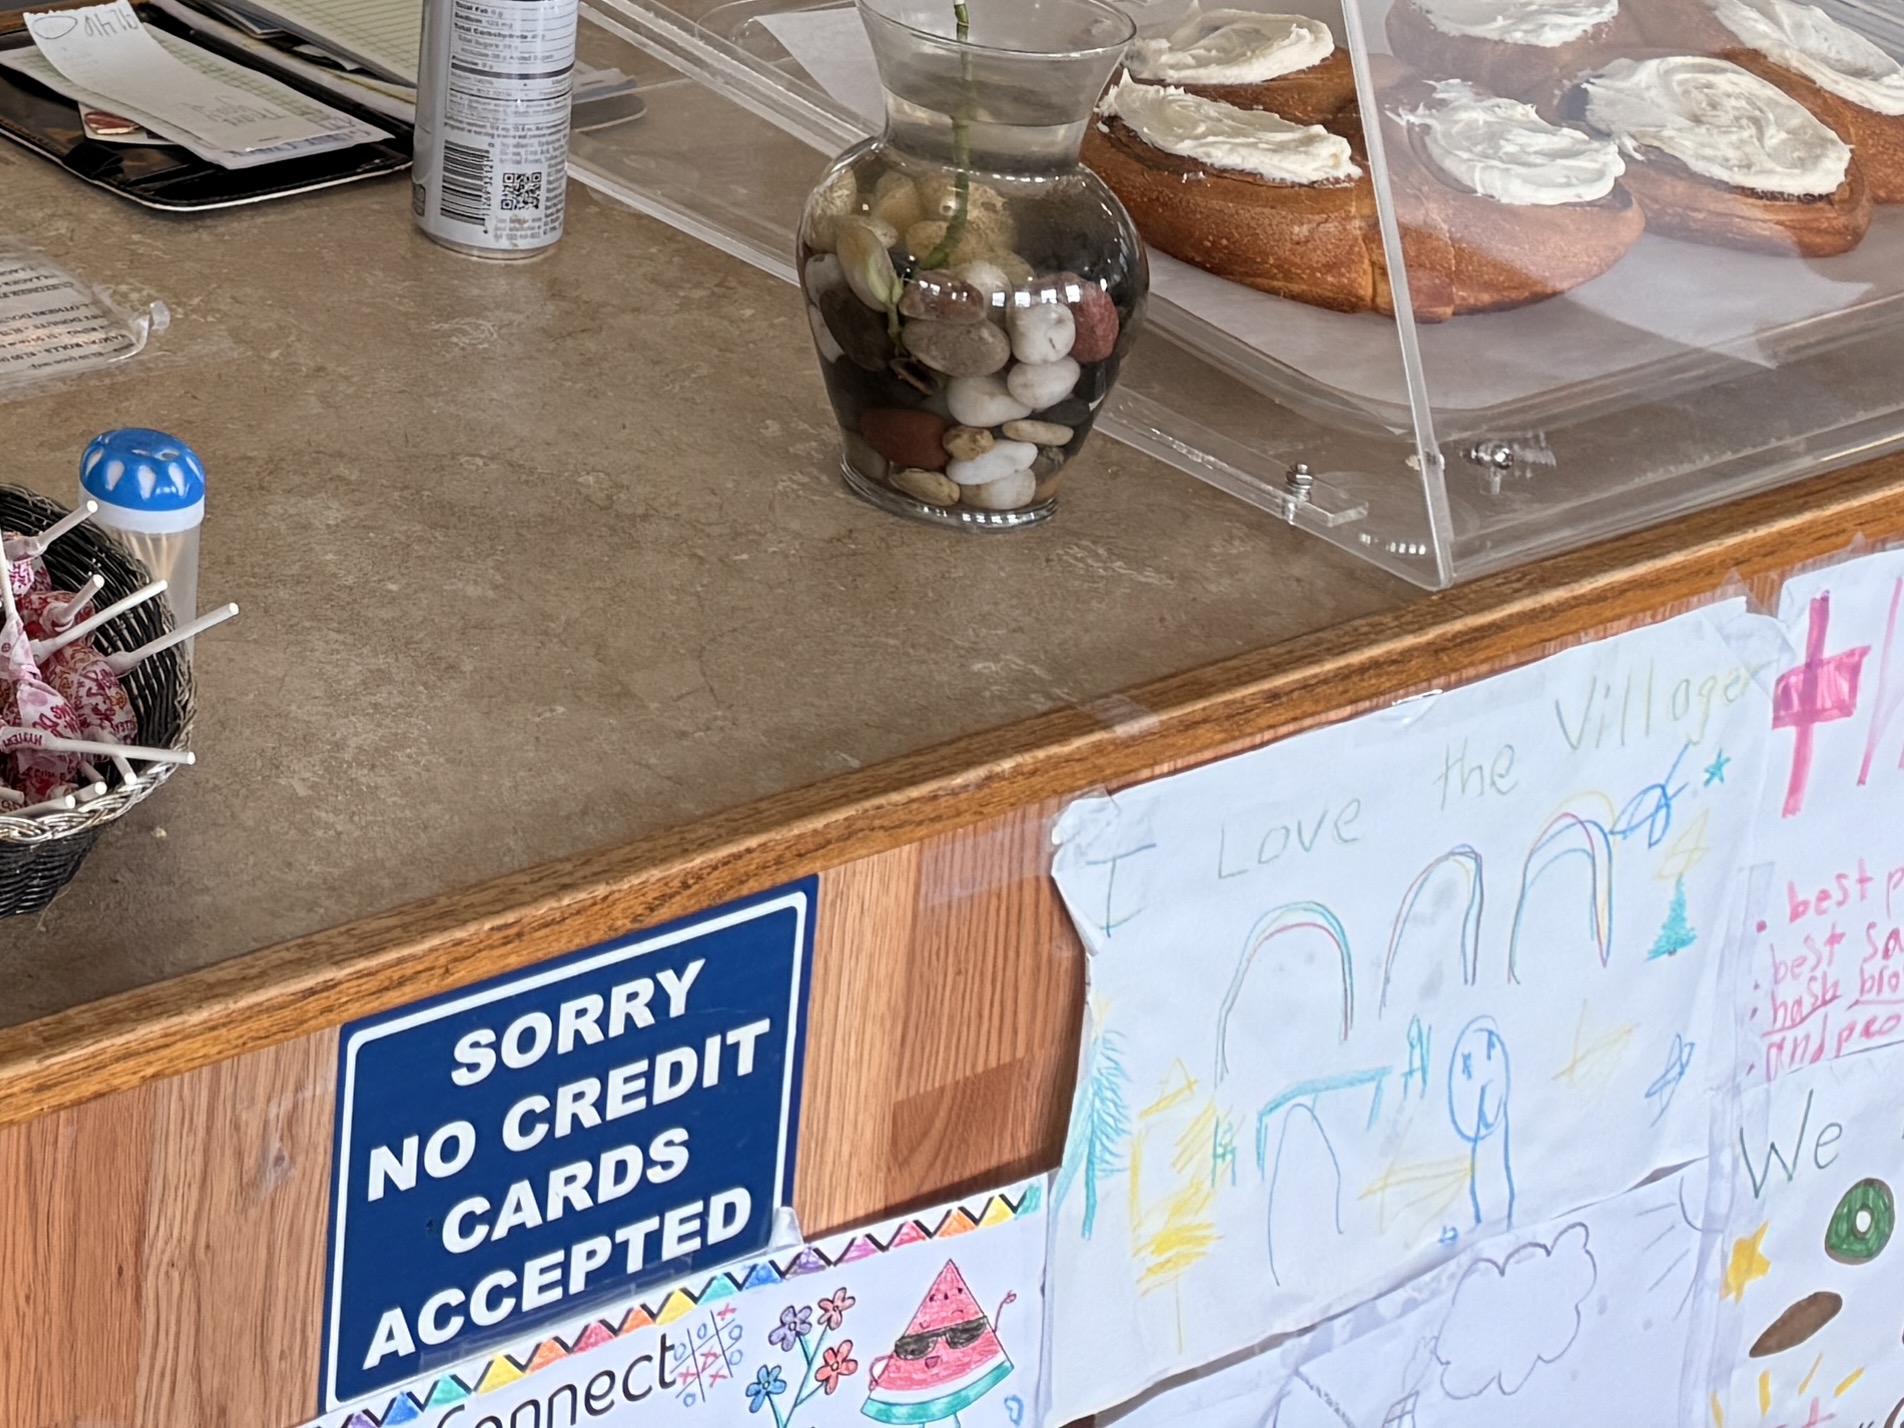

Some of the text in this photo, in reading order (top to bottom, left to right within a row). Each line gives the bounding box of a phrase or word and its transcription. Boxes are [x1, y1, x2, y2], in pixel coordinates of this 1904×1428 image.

[1216, 795, 1365, 881] Love
[1433, 737, 1520, 812] the
[450, 959, 708, 1087] SORRY
[367, 1017, 773, 1203] NO CREDIT
[1740, 1088, 1844, 1199] We
[440, 1127, 691, 1257] CARDS
[361, 1187, 753, 1372] ACCEPTED
